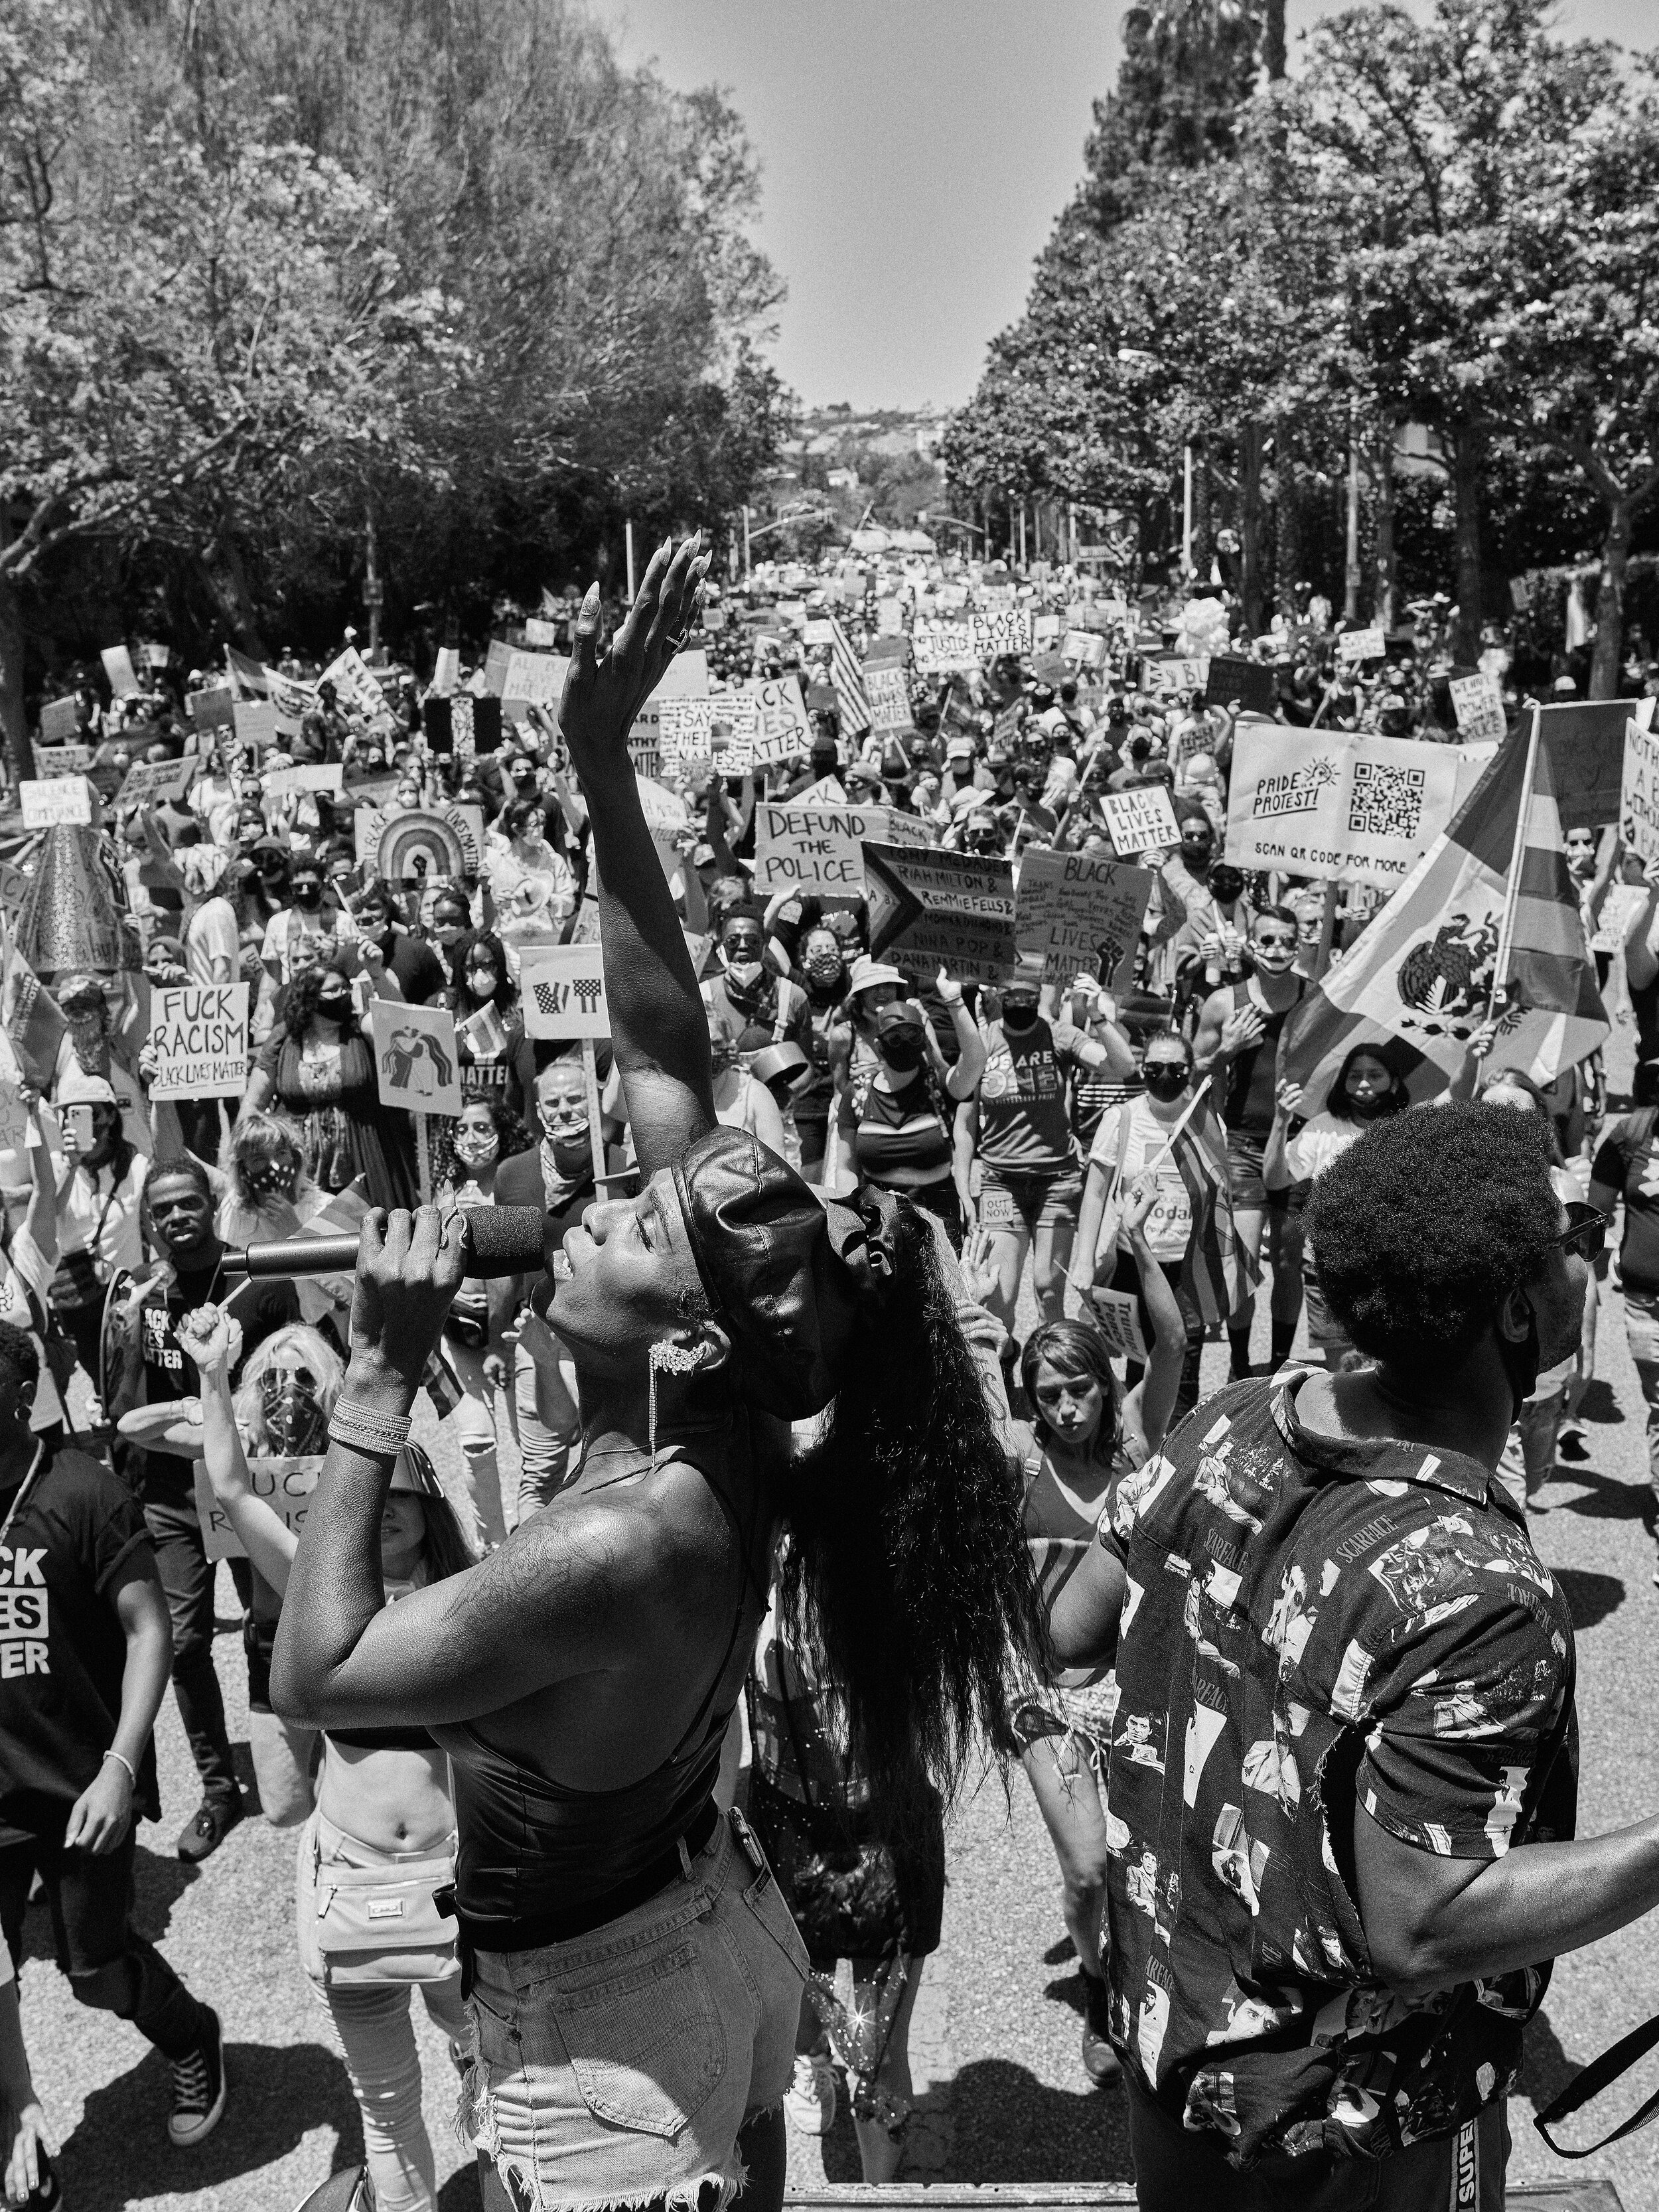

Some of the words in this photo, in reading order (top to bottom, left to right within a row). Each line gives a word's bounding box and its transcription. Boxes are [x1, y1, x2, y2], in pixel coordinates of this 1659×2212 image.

[974, 612, 1025, 628] BLACK
[977, 624, 1027, 640] LIVES
[974, 636, 1030, 654] MATTER
[683, 709, 713, 727] SAY
[1257, 772, 1300, 795] PRIDE
[1109, 792, 1157, 815] BLACK
[1253, 788, 1319, 815] PROTEST!
[768, 810, 866, 839] DEFUND
[1118, 809, 1162, 831] LIVES
[793, 839, 836, 855] THE
[1118, 826, 1177, 851] MATTER
[765, 856, 861, 883] POLICE
[1255, 842, 1285, 857] SCAN
[1291, 847, 1306, 860] QR
[1311, 849, 1341, 865] CODE
[1346, 854, 1370, 868] FOR
[1374, 859, 1406, 874] MORE
[897, 865, 933, 883] RIAH
[934, 870, 984, 890] MILTON
[1064, 857, 1116, 885] BLACK
[1050, 926, 1098, 951] LIVES
[164, 988, 234, 1022] FUCK
[154, 1022, 244, 1057] RACISM
[1015, 1050, 1054, 1069] ARE
[987, 1199, 1009, 1209] OUT
[987, 1209, 1009, 1217] NOW
[1203, 1527, 1249, 1573] SCARFACE
[1336, 1514, 1399, 1564] SCARFACE
